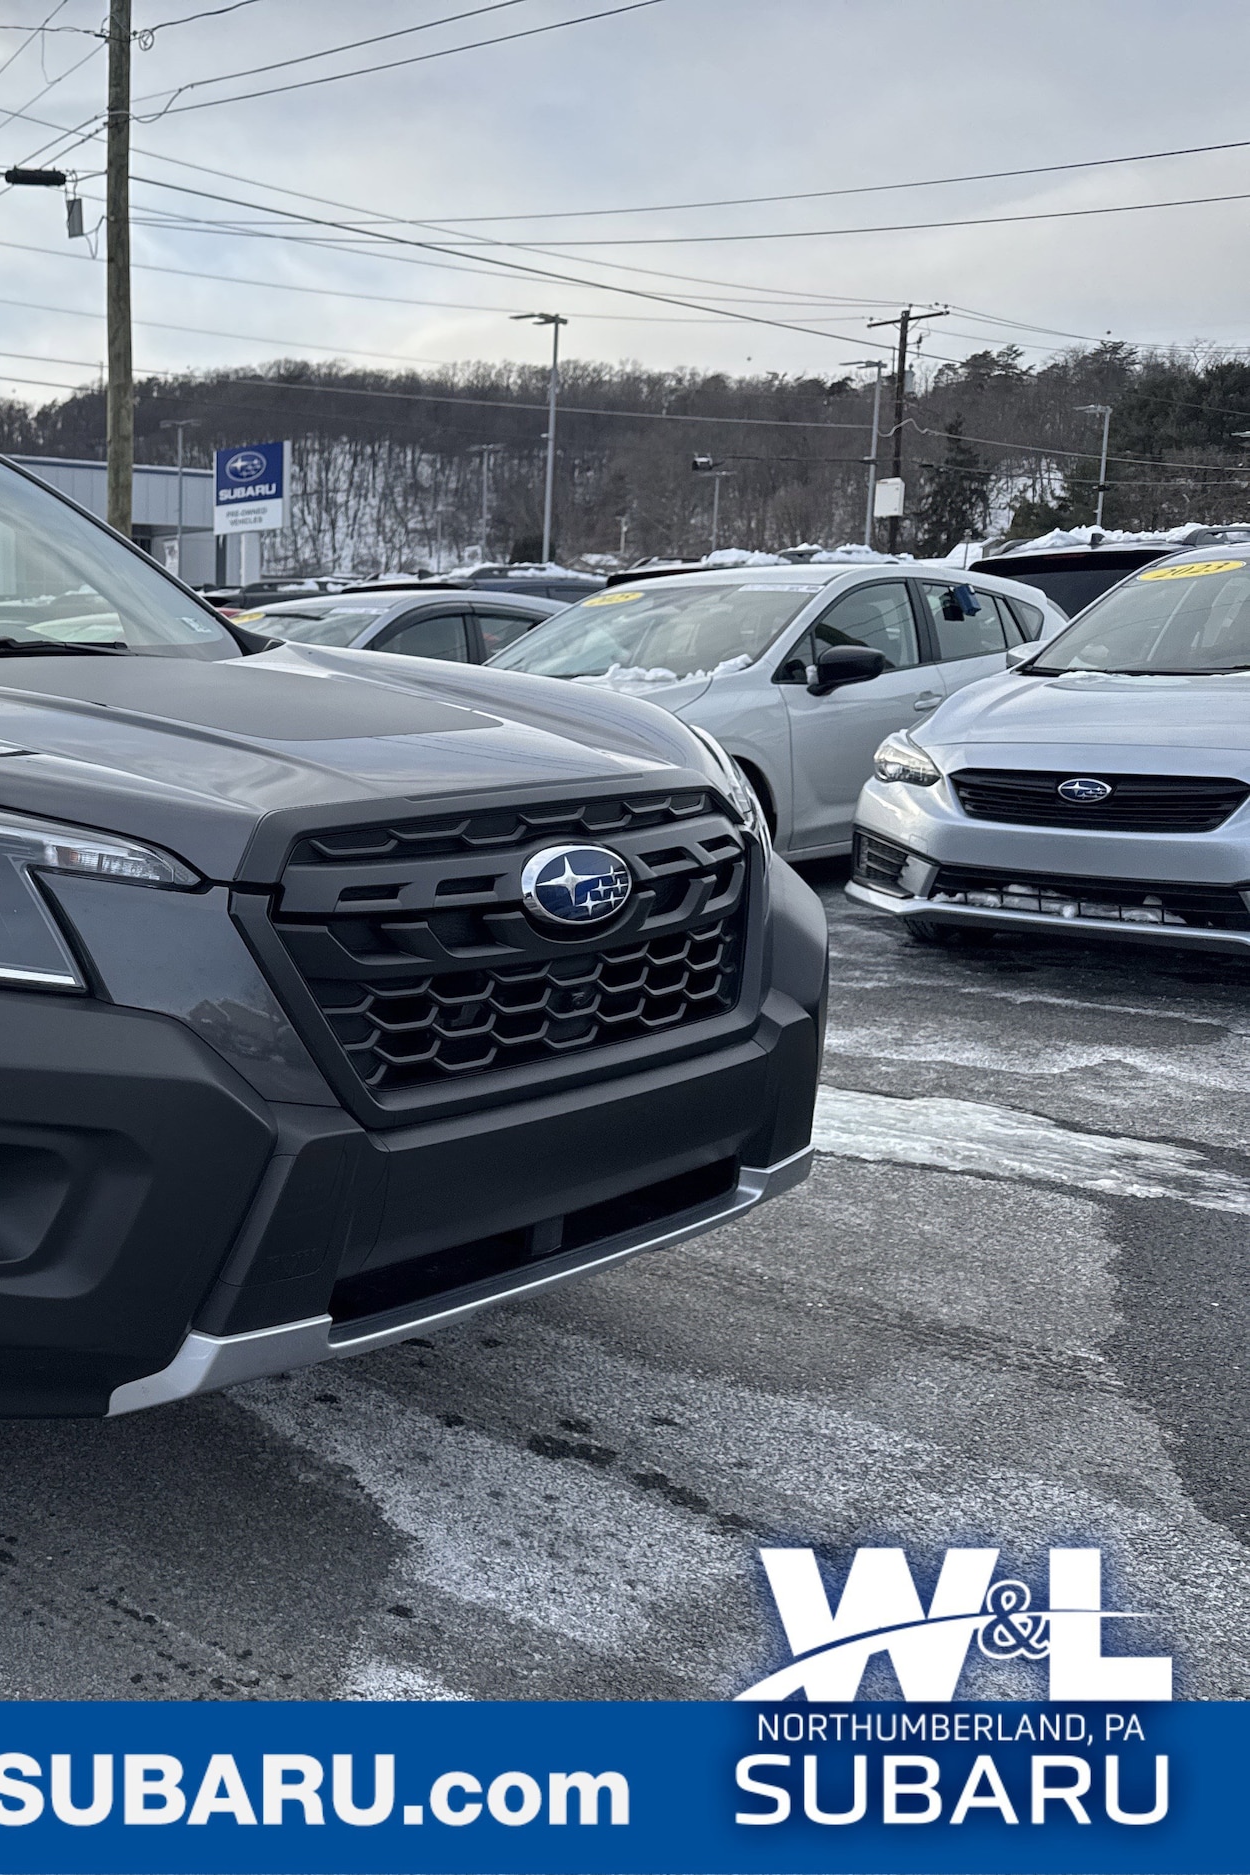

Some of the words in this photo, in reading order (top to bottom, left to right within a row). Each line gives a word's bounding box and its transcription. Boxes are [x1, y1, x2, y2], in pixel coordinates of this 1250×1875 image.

[219, 482, 276, 501] SUBARU
[226, 507, 268, 517] PRE-OWNED
[230, 517, 262, 526] VEHICLES
[1151, 561, 1232, 578] 2023
